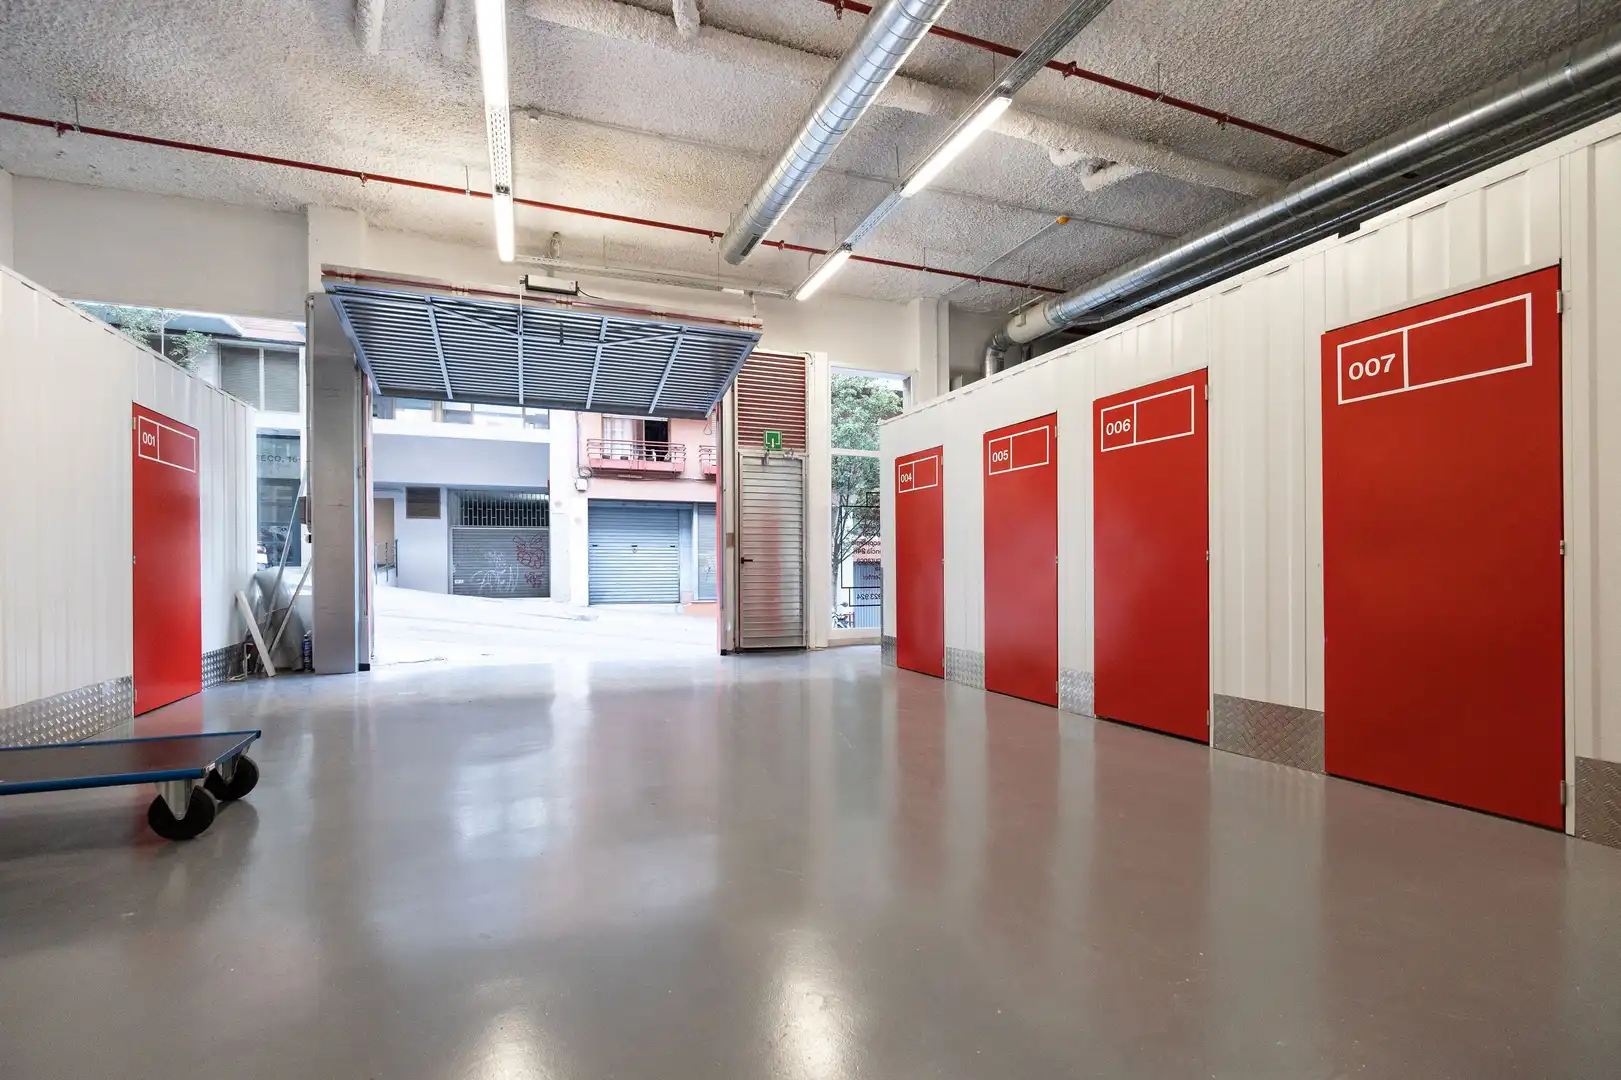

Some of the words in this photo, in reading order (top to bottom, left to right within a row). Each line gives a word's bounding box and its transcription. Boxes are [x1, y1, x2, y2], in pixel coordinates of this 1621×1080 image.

[1348, 352, 1396, 381] 007
[1105, 419, 1131, 436] 006
[142, 432, 156, 447] 001
[992, 449, 1009, 463] 005
[900, 473, 912, 483] 004
